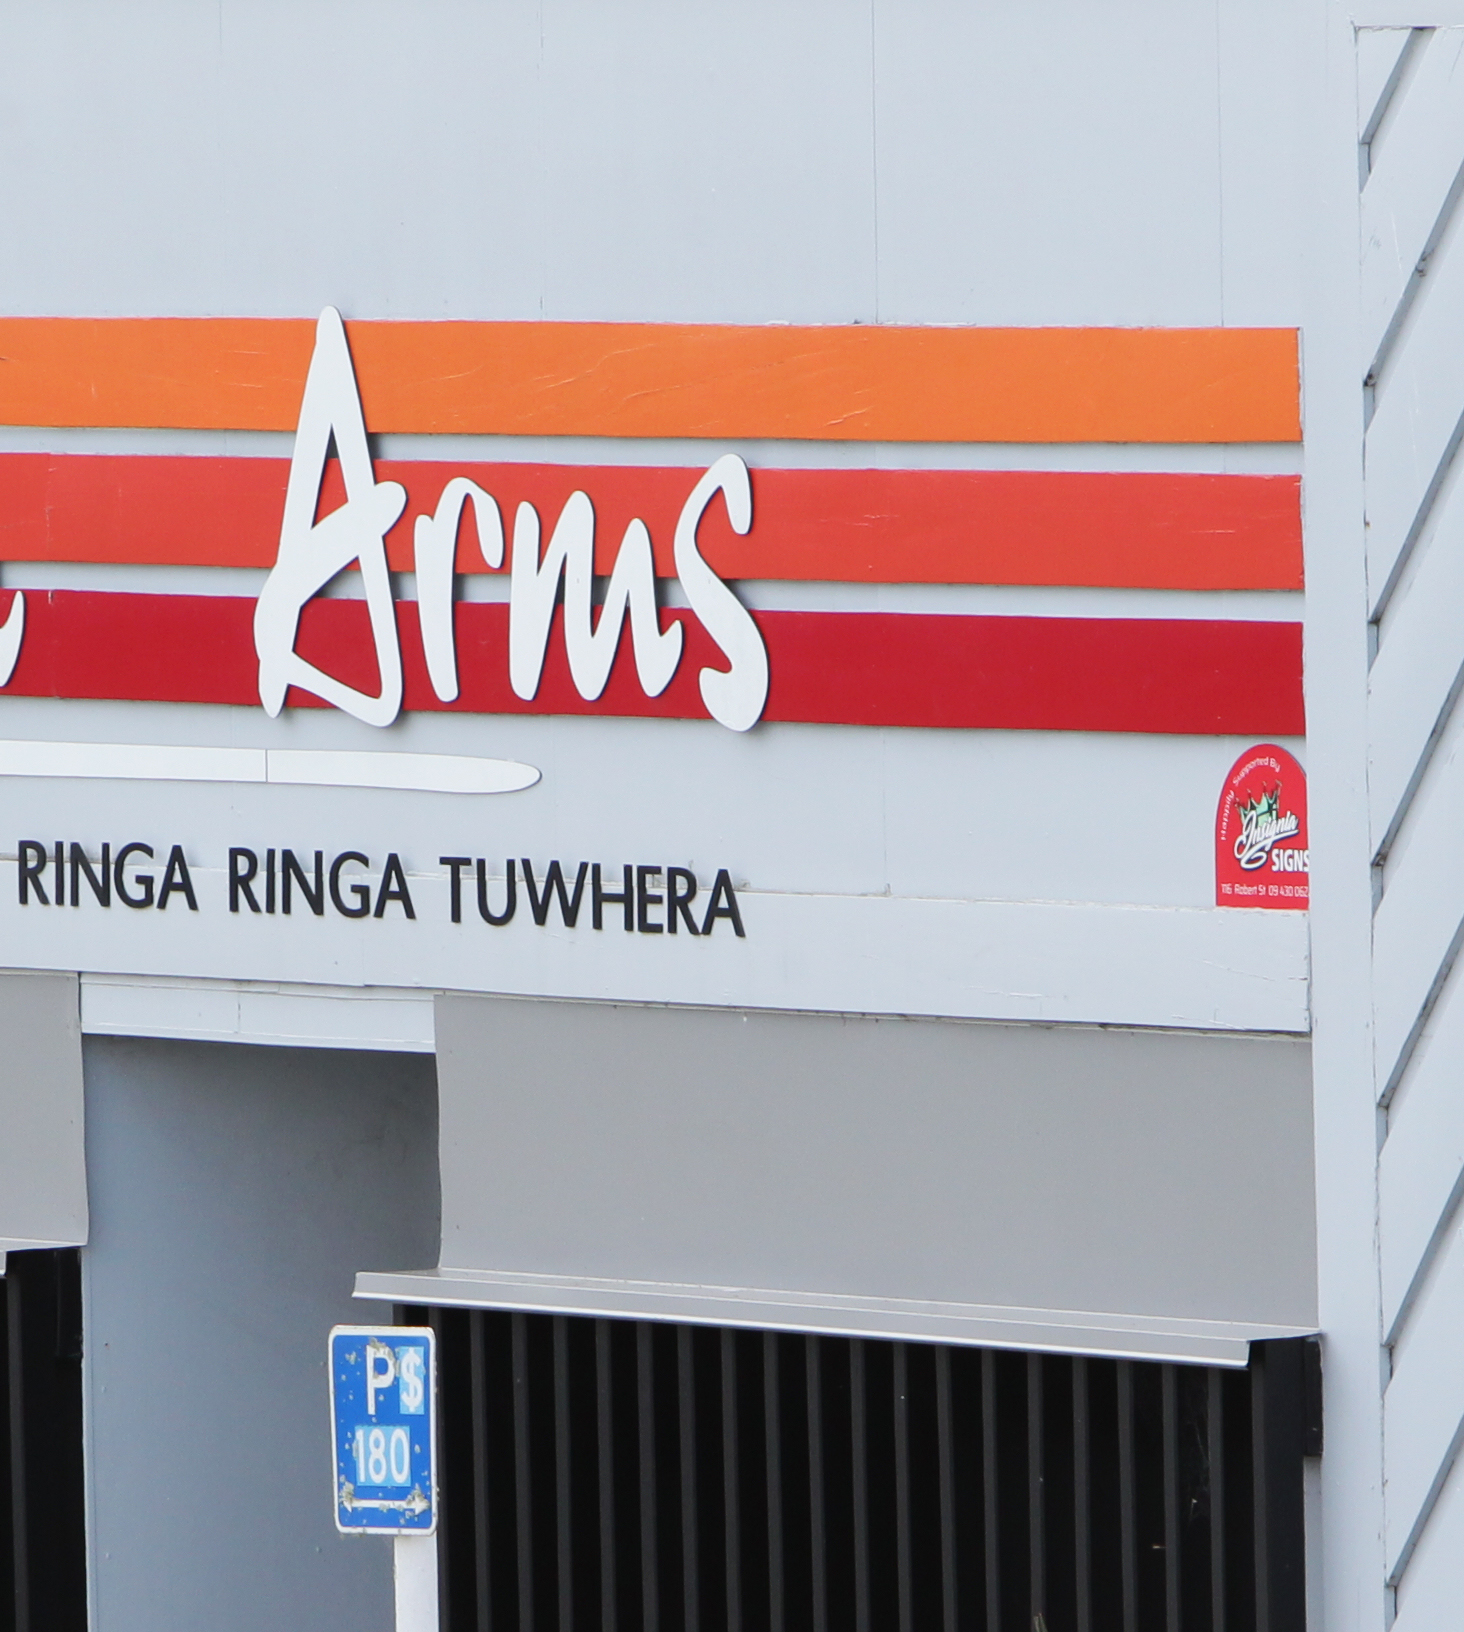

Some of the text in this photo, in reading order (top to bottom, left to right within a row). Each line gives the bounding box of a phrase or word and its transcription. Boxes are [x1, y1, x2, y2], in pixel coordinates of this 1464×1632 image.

[254, 304, 770, 732] Arms
[1232, 756, 1269, 787] Supported
[1234, 810, 1300, 871] Insignia
[1271, 848, 1310, 872] SIGNS
[17, 839, 200, 912] RINGA
[228, 846, 416, 921] RINGA
[438, 856, 747, 939] TUWHERA
[1257, 884, 1266, 896] St
[1268, 884, 1279, 897] 09
[355, 1428, 411, 1484] 180
